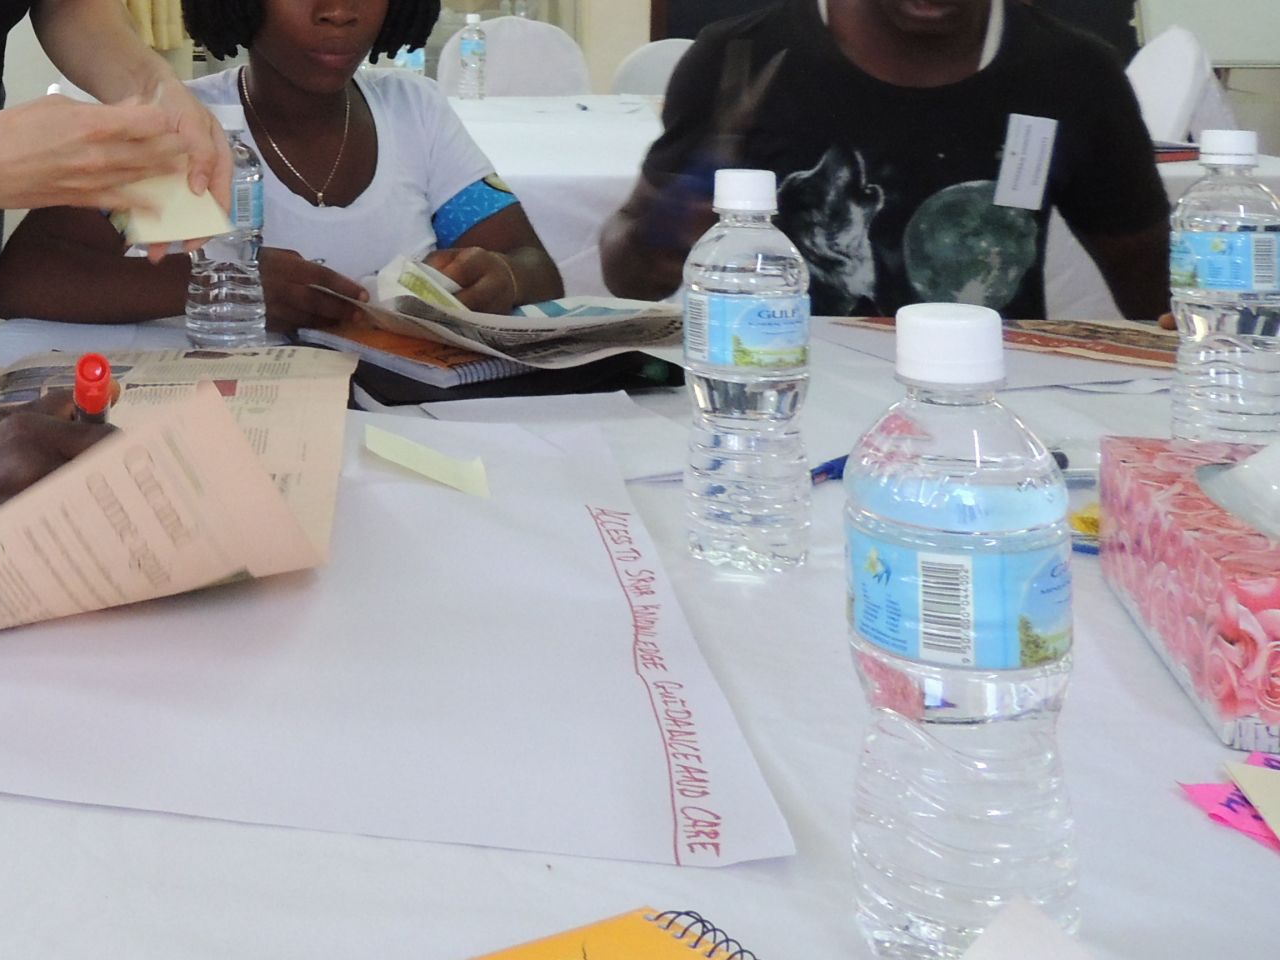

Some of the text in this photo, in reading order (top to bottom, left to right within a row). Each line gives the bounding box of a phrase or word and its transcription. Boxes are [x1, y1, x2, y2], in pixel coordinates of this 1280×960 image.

[593, 507, 632, 548] ACCESS
[632, 604, 668, 674] KNOWLEDGE
[679, 805, 723, 859] CARE
